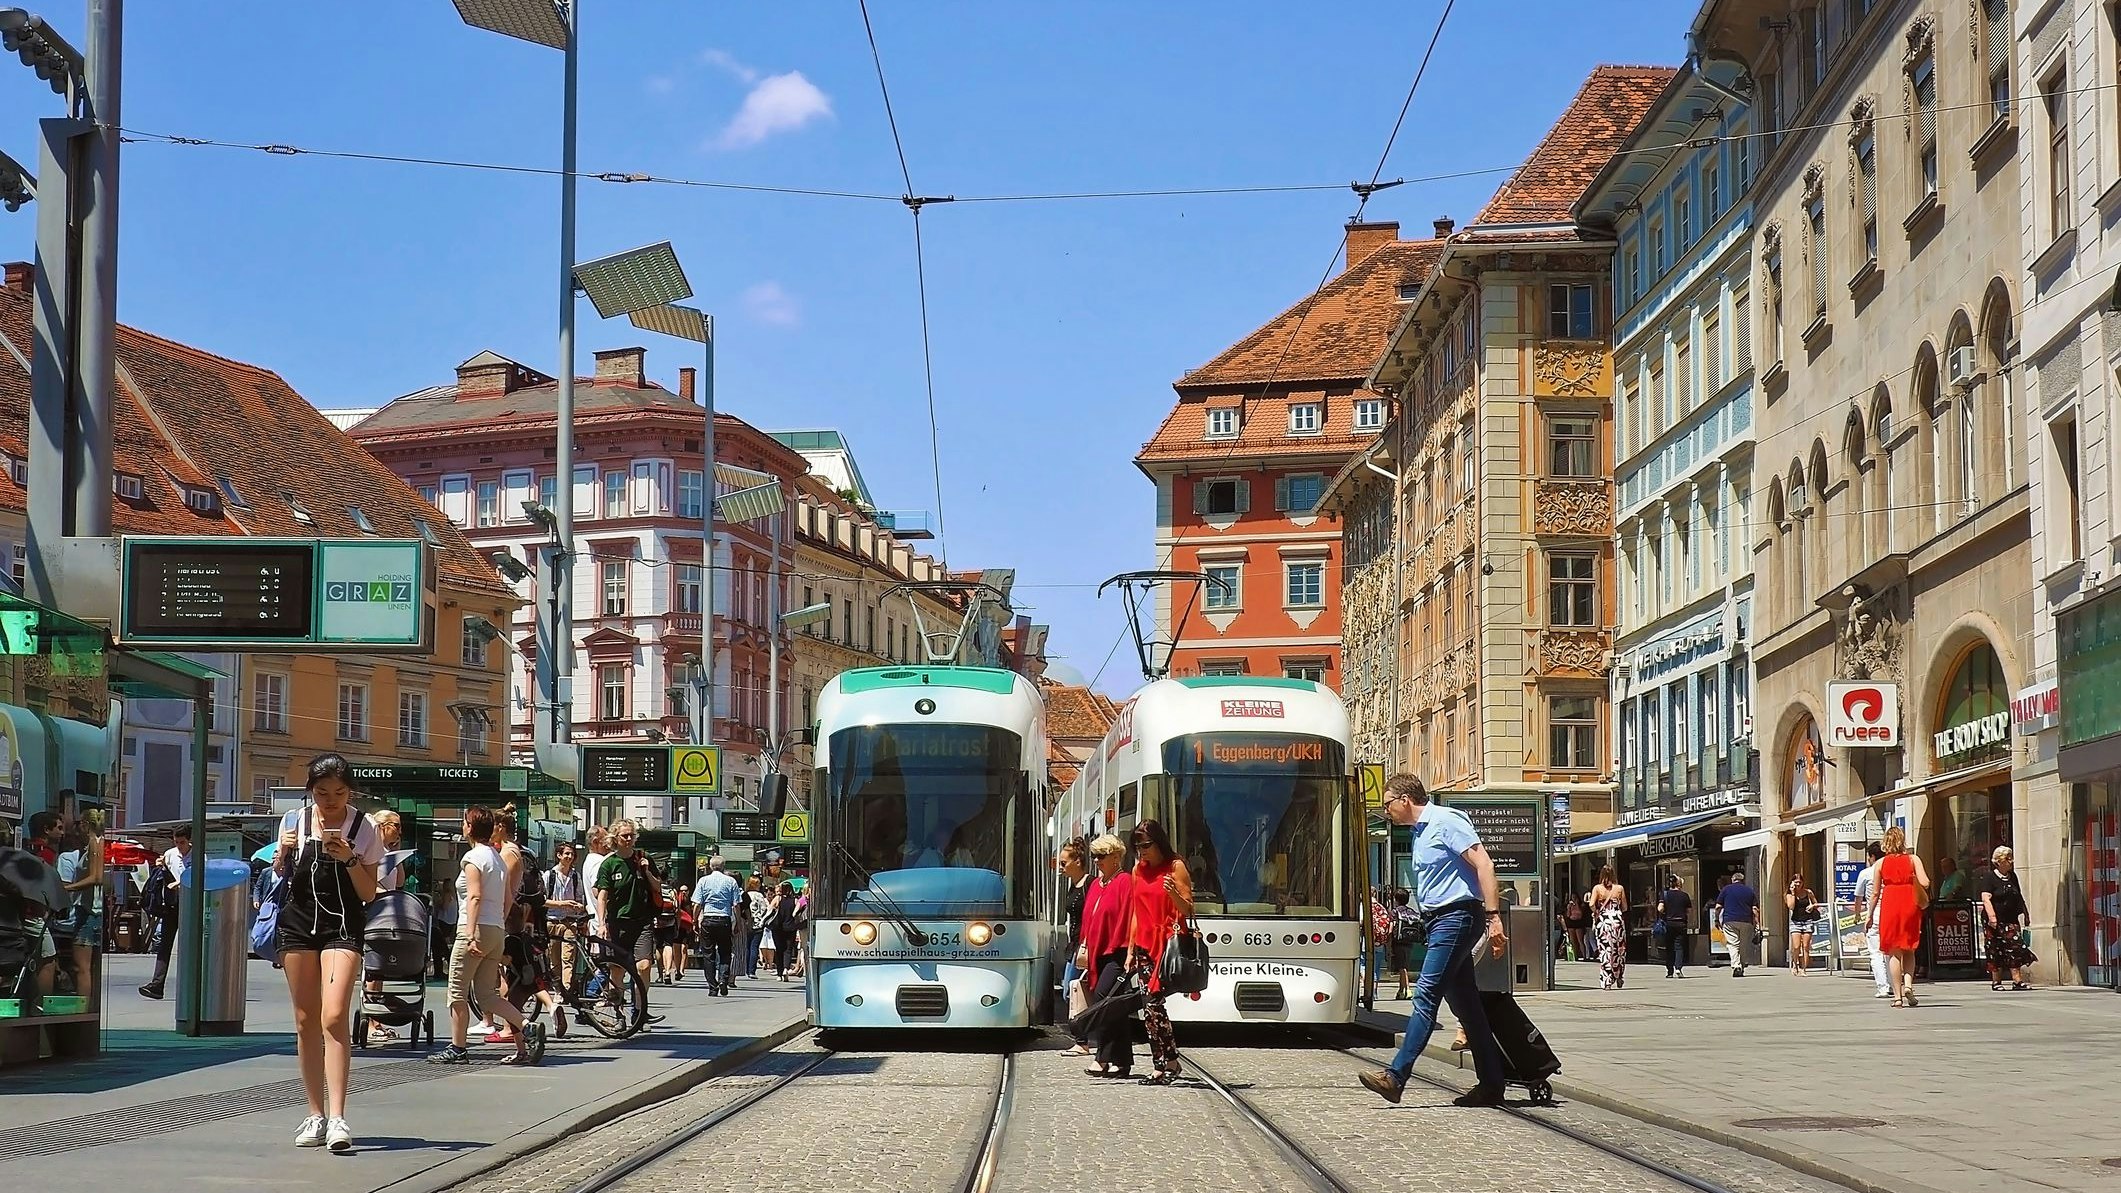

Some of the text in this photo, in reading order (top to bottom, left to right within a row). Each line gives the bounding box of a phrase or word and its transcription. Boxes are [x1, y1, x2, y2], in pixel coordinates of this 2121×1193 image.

[378, 574, 412, 582] HOLDING
[327, 583, 410, 600] GRAZ
[387, 603, 412, 611] LINIEN
[1224, 700, 1281, 709] KLEINE
[2011, 694, 2039, 724] TALLY
[1225, 707, 1283, 717] ZEITUNG
[1835, 726, 1891, 741] ruefa
[1934, 711, 2009, 759] THE BODY SHOP
[1193, 740, 1322, 764] 1 Eggenberg/UKH
[352, 768, 393, 778] TICKETS
[438, 768, 479, 778] TICKETS
[1682, 788, 1745, 813] UHRENHAUS
[1639, 834, 1696, 856] WEIKHARD
[1937, 925, 1969, 937] SALE
[930, 932, 961, 946] 654
[1244, 933, 1272, 946] 663
[1937, 937, 1969, 946] GROSSE
[837, 948, 1000, 959] www.schauspielhaus-graz.com
[1208, 963, 1309, 977] Meine Kleine.
